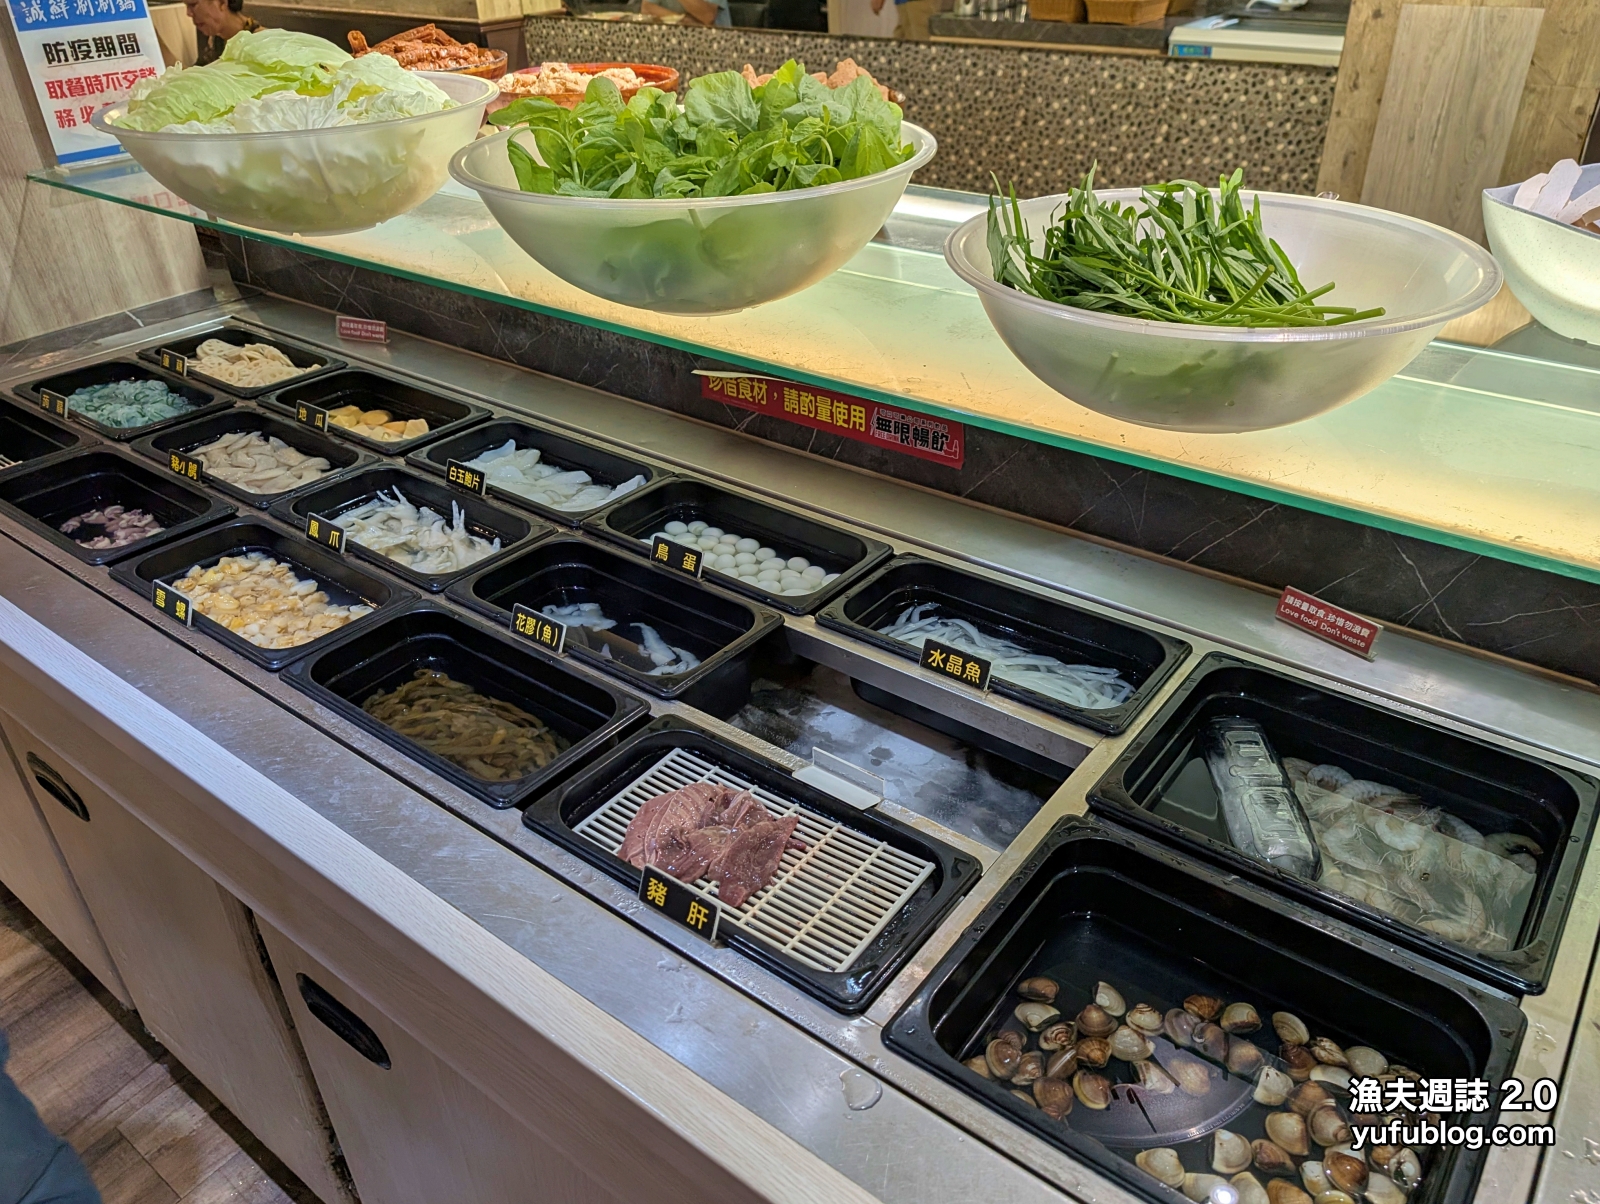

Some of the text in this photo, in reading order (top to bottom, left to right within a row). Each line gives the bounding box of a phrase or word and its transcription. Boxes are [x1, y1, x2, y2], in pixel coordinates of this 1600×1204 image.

[42, 33, 141, 65] 防疫期間
[298, 406, 324, 428] 地瓜
[875, 415, 950, 453] 無限暢飲
[655, 543, 697, 572] 鳥蛋
[1280, 604, 1366, 648] Love food Don't waste
[927, 648, 981, 684] 水晶魚
[647, 877, 709, 930] 豬肝
